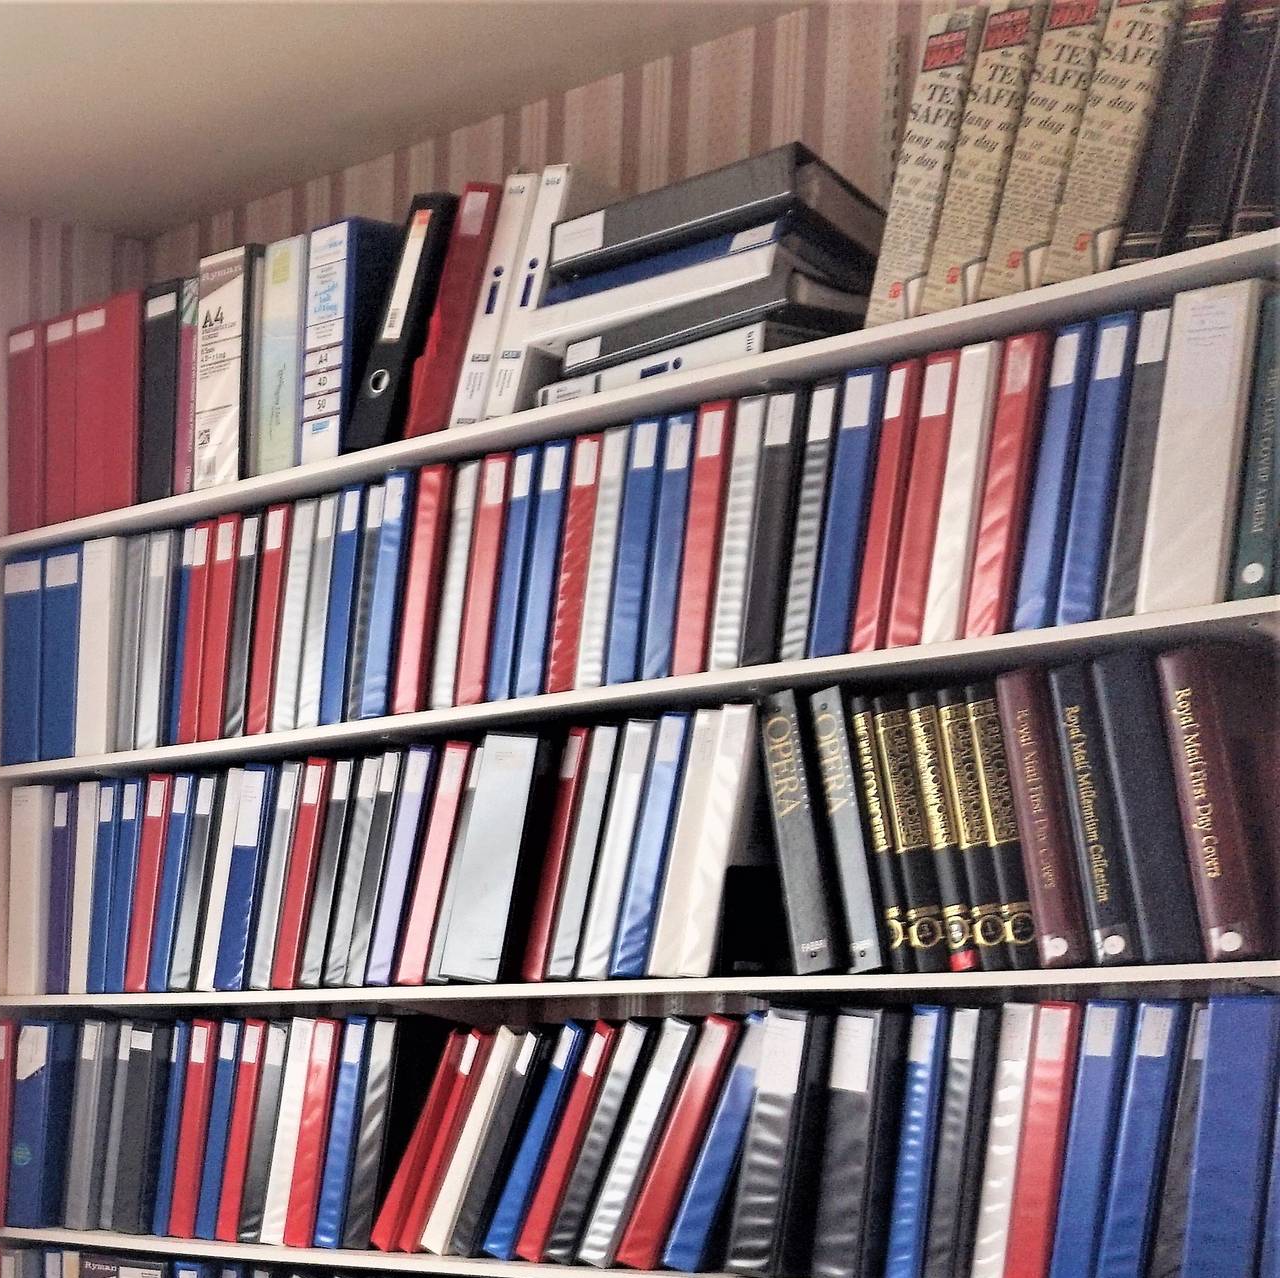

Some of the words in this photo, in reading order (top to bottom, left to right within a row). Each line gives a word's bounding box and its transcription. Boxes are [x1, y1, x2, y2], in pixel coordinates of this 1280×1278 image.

[202, 306, 224, 328] A4
[319, 353, 328, 364] A4
[1064, 705, 1087, 739] Royal
[1170, 688, 1200, 728] Royal
[1016, 708, 1036, 746] Royal
[816, 713, 848, 816] OPERA
[1072, 741, 1092, 770] Mail
[1184, 733, 1207, 765] Mail
[767, 716, 801, 819] OPERA
[1023, 750, 1040, 782] Mail
[1029, 786, 1044, 815] First
[1190, 770, 1208, 799] First
[1077, 772, 1099, 843] Millennium
[1192, 803, 1212, 831] Day
[1202, 835, 1223, 878] Covers
[1090, 844, 1109, 903] Collection
[85, 1261, 117, 1272] Ryman
